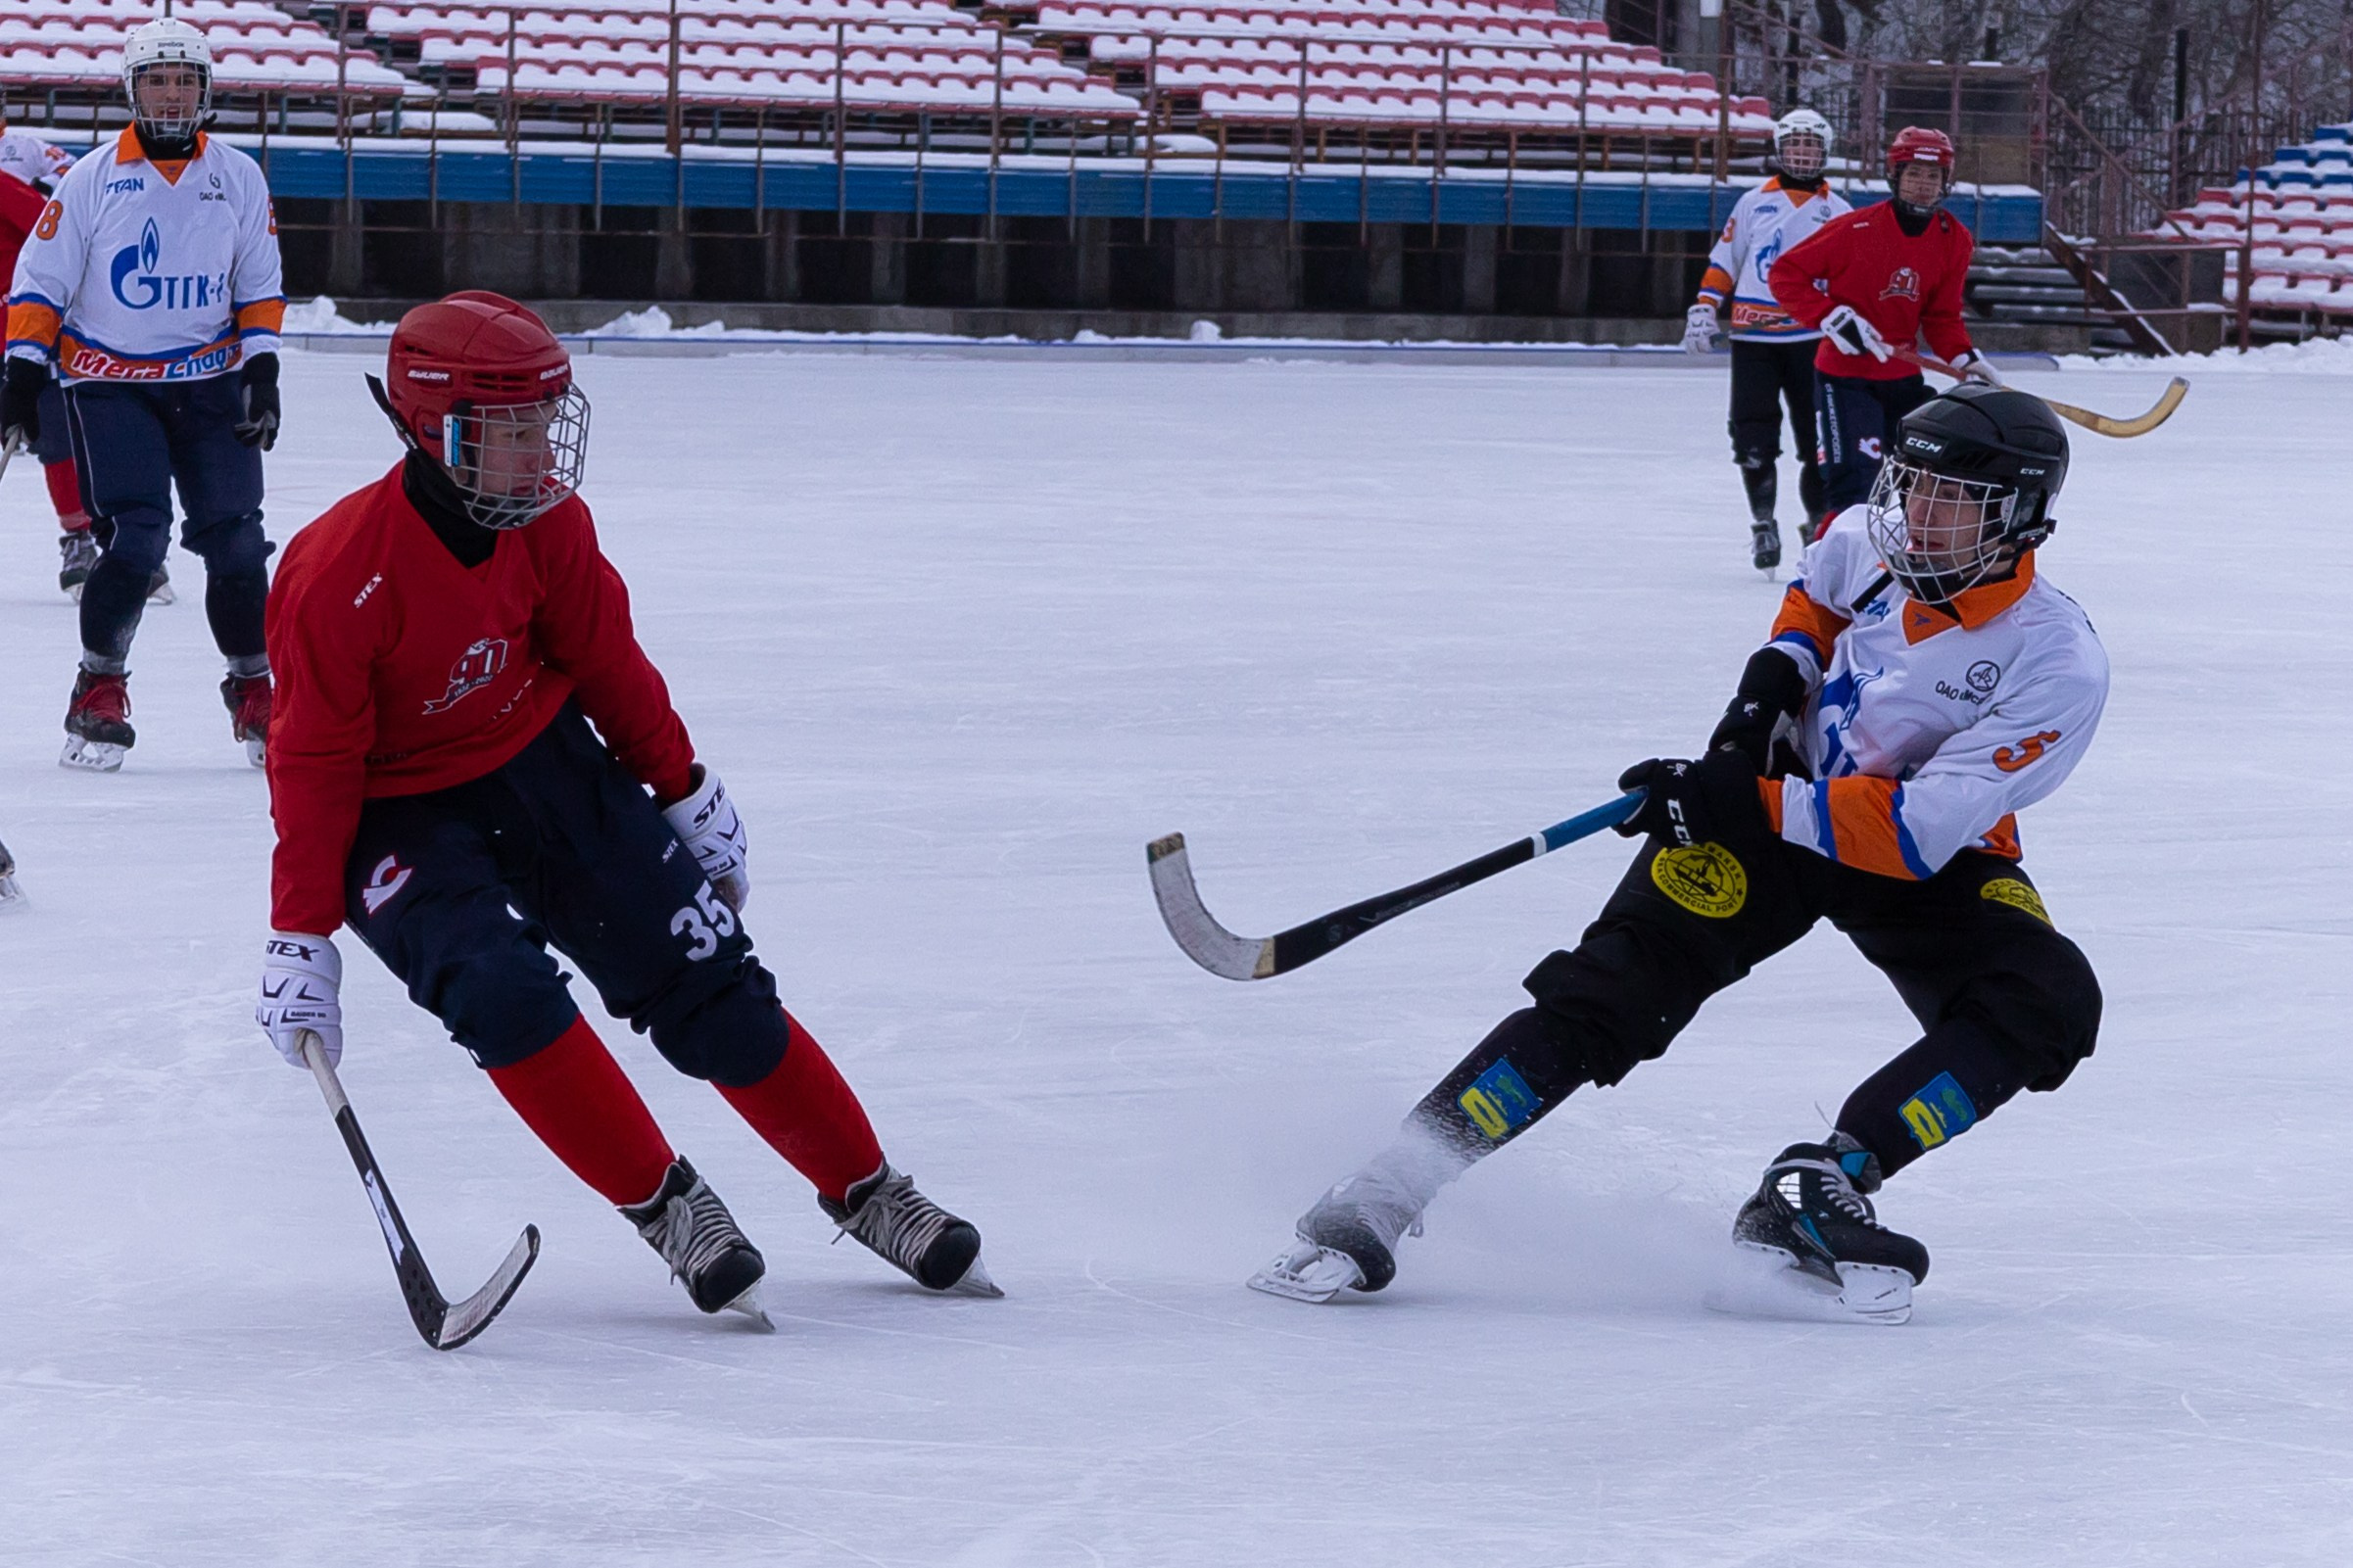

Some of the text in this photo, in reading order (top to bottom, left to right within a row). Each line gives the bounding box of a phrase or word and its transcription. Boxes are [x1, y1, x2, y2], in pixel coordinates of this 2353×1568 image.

[36, 200, 63, 241] 8
[1905, 437, 1943, 453] CCM
[2020, 467, 2045, 476] CCM
[354, 572, 383, 608] STEX
[1936, 681, 1958, 701] ОАО
[694, 778, 726, 830] STE
[661, 837, 680, 864] STEX
[1658, 873, 1712, 912] COMMERCIAL
[1715, 897, 1738, 912] PORT
[670, 879, 735, 961] 35
